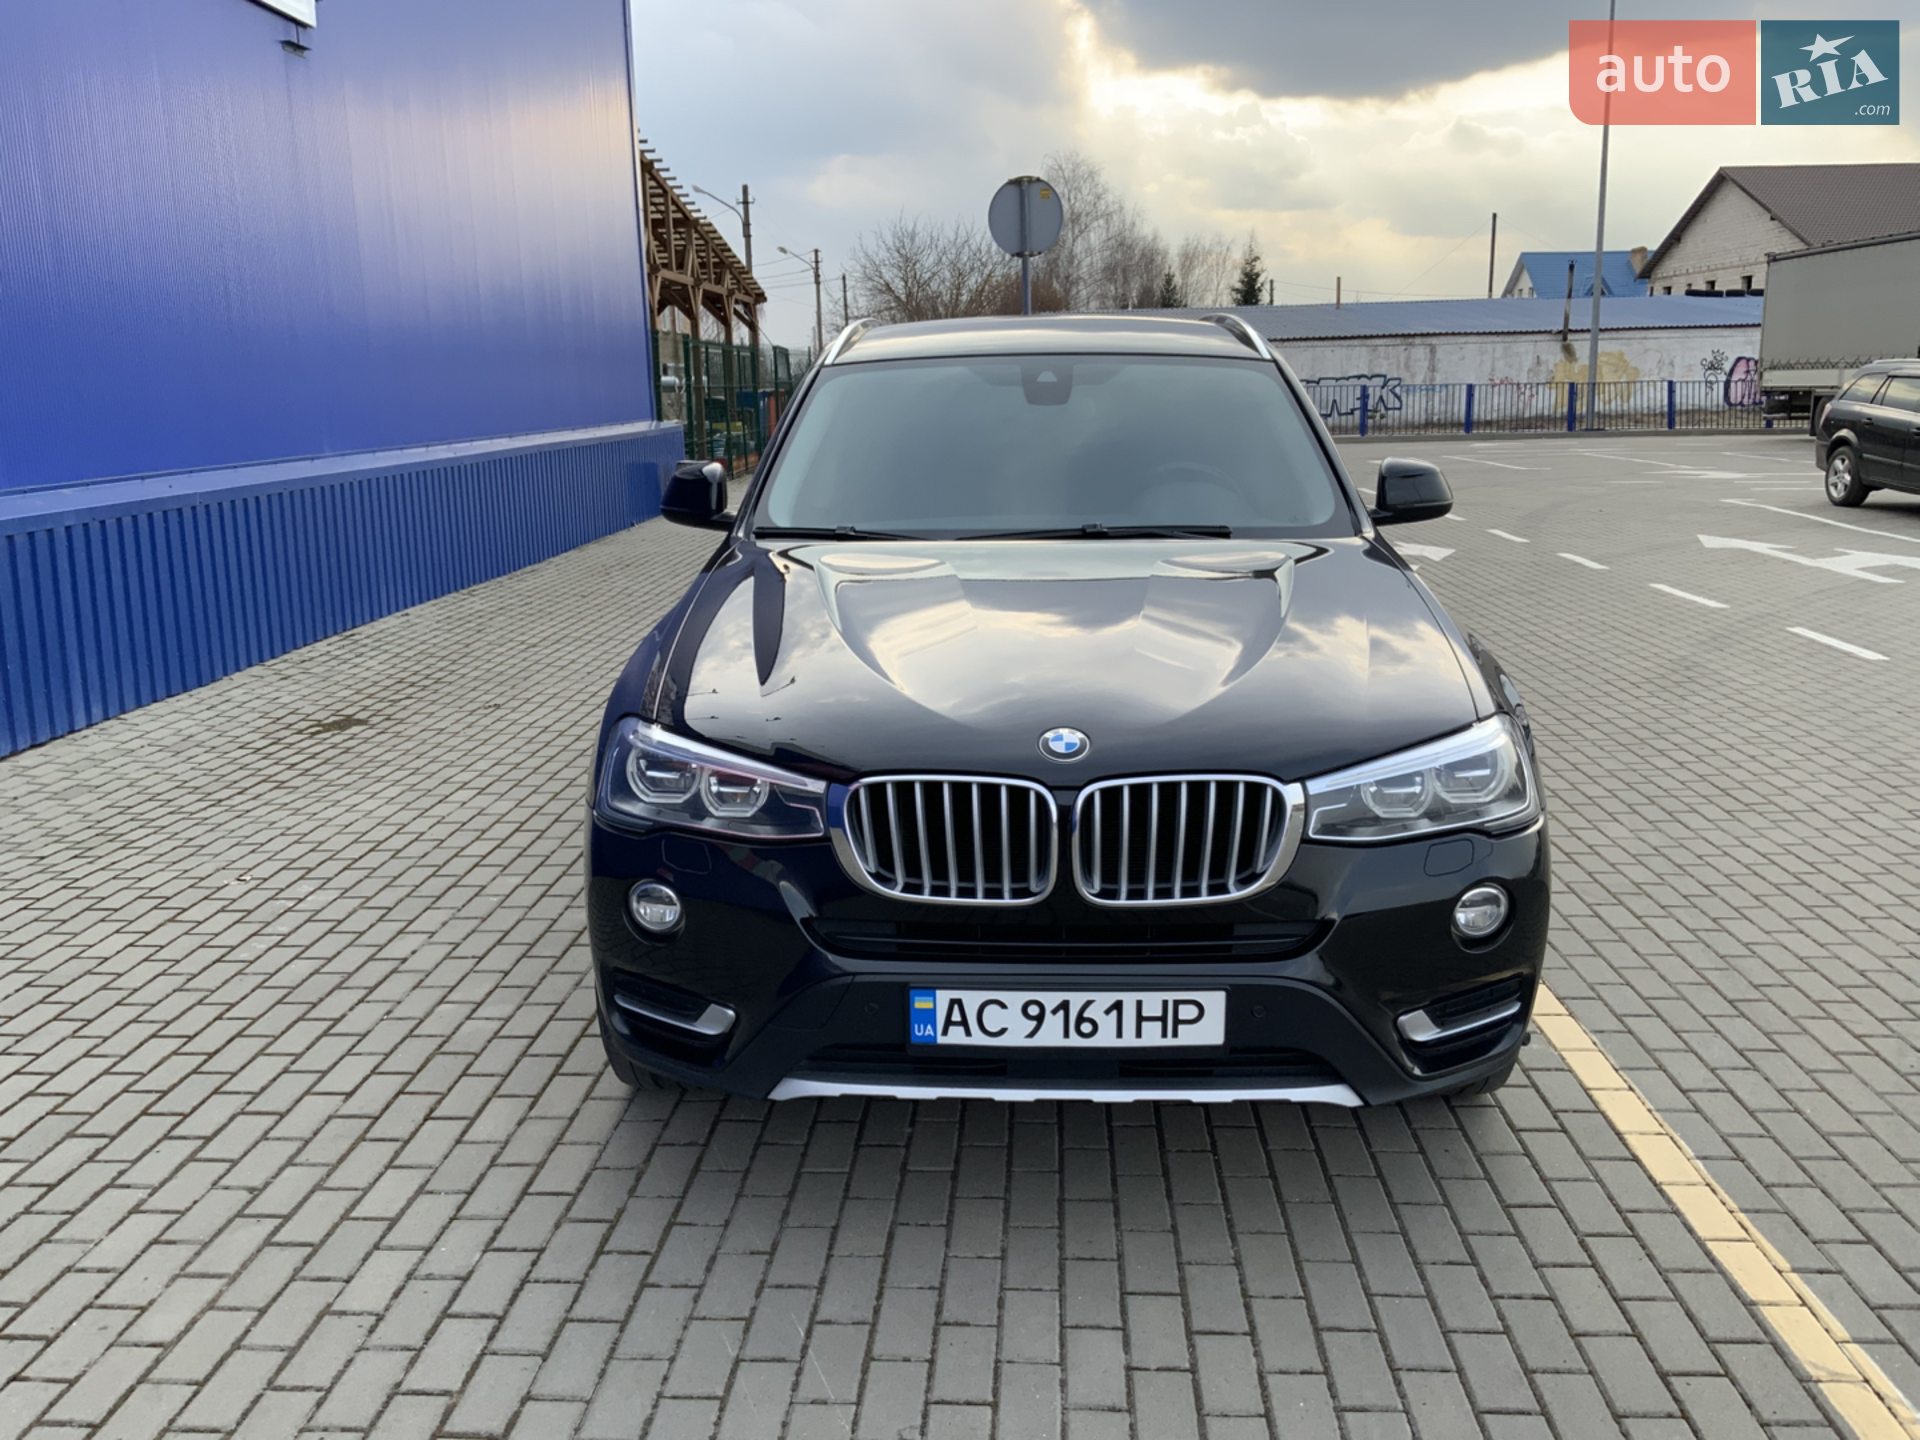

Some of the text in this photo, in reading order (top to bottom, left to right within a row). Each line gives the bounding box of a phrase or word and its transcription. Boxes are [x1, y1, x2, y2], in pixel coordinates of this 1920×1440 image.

[914, 1023, 934, 1037] UA
[941, 998, 1205, 1039] AC 9161 HP
